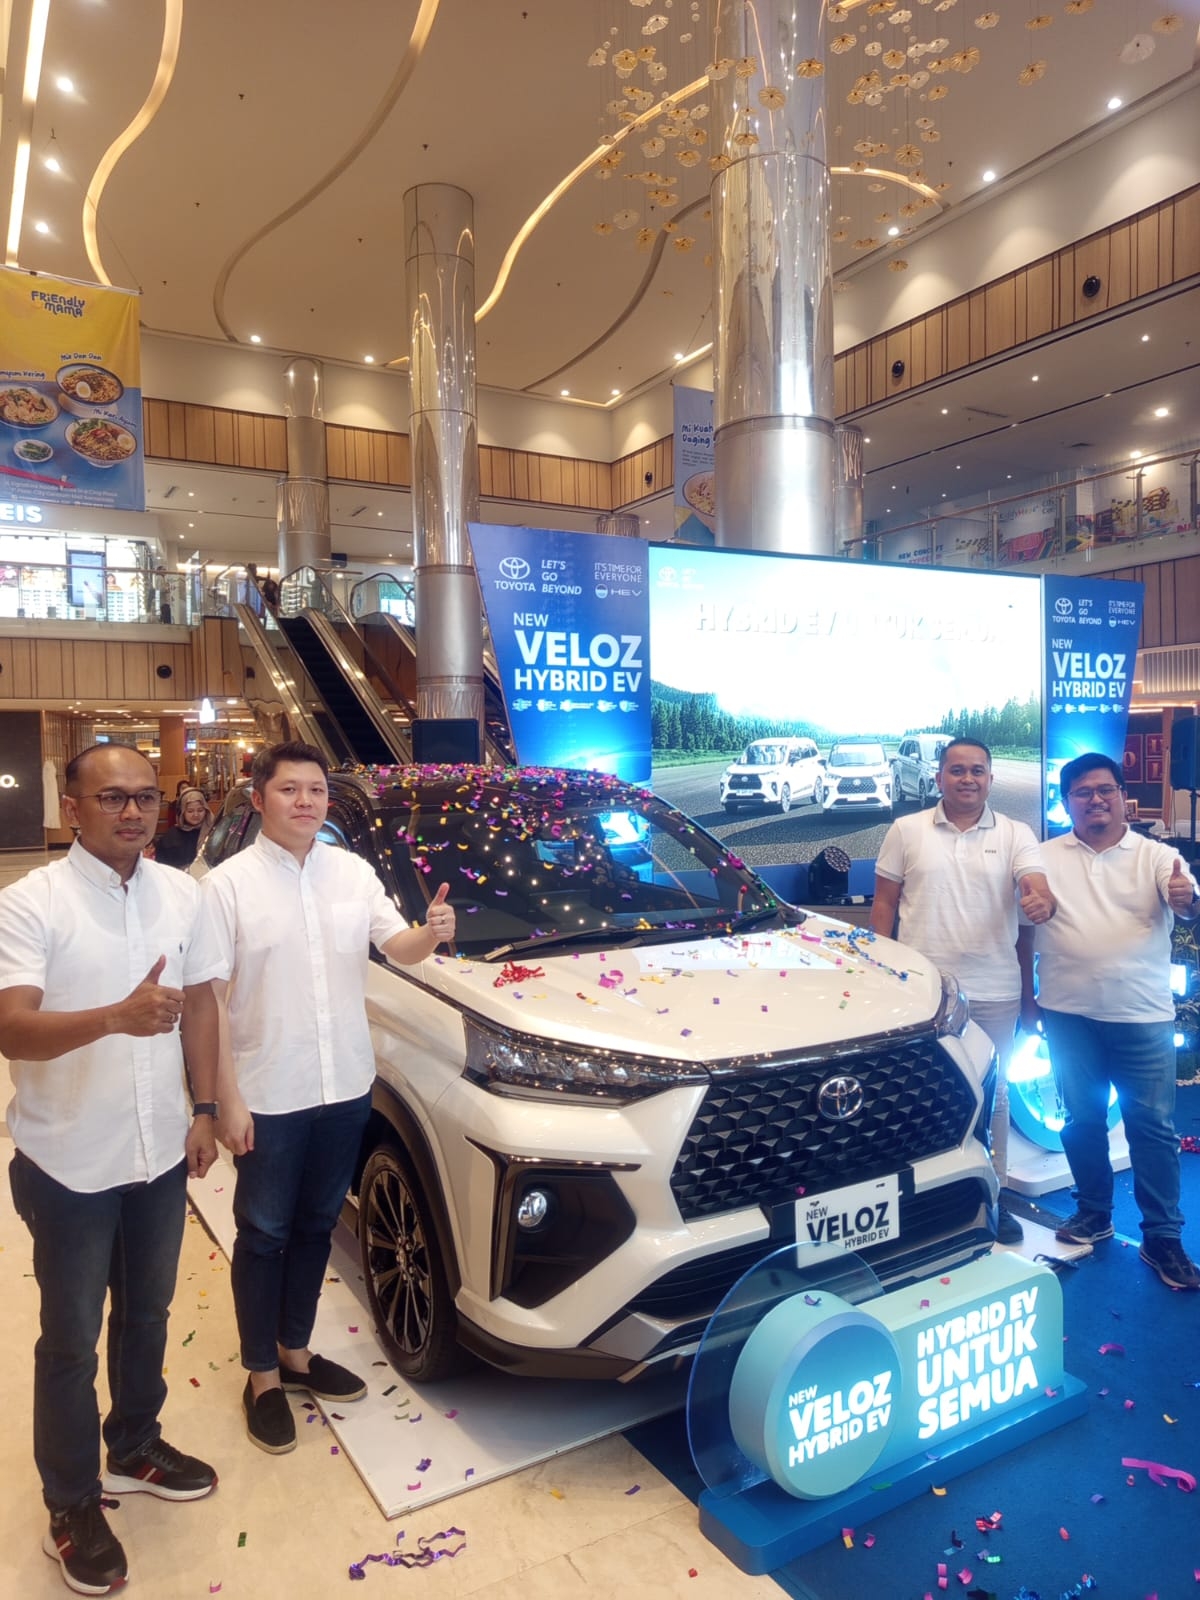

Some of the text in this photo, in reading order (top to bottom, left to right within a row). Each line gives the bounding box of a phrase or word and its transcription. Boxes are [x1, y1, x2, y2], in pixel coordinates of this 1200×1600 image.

[693, 421, 714, 433] Kuah
[682, 433, 711, 448] Daging
[541, 559, 566, 571] LET'S
[607, 563, 626, 573] TIME
[626, 565, 642, 574] FOR
[541, 571, 558, 582] GO
[594, 571, 642, 583] EVERYONE
[494, 580, 536, 592] TOYOTA
[541, 583, 582, 595] BEYOND
[611, 588, 642, 597] HEV
[1108, 607, 1136, 615] EVERYONE
[513, 612, 549, 627] NEW
[1052, 615, 1076, 624] TOYOTA
[1078, 617, 1102, 625] BEYOND
[514, 630, 642, 668] VELOZ
[1052, 638, 1073, 649] NEW
[1053, 652, 1126, 679] VELOZ
[514, 669, 642, 693] HYBRID EV
[1052, 681, 1126, 698] HYBRID EV
[806, 1205, 829, 1221] NEW
[806, 1201, 889, 1246] VELOZ
[844, 1227, 890, 1250] HYBRID EV
[917, 1286, 1039, 1359] HYBRID EV
[917, 1314, 1038, 1398] UNTUK
[788, 1384, 818, 1408] NEW
[918, 1355, 1039, 1439] SEMUA
[788, 1370, 892, 1441] VELOZ
[788, 1403, 892, 1467] HYBRID EV
